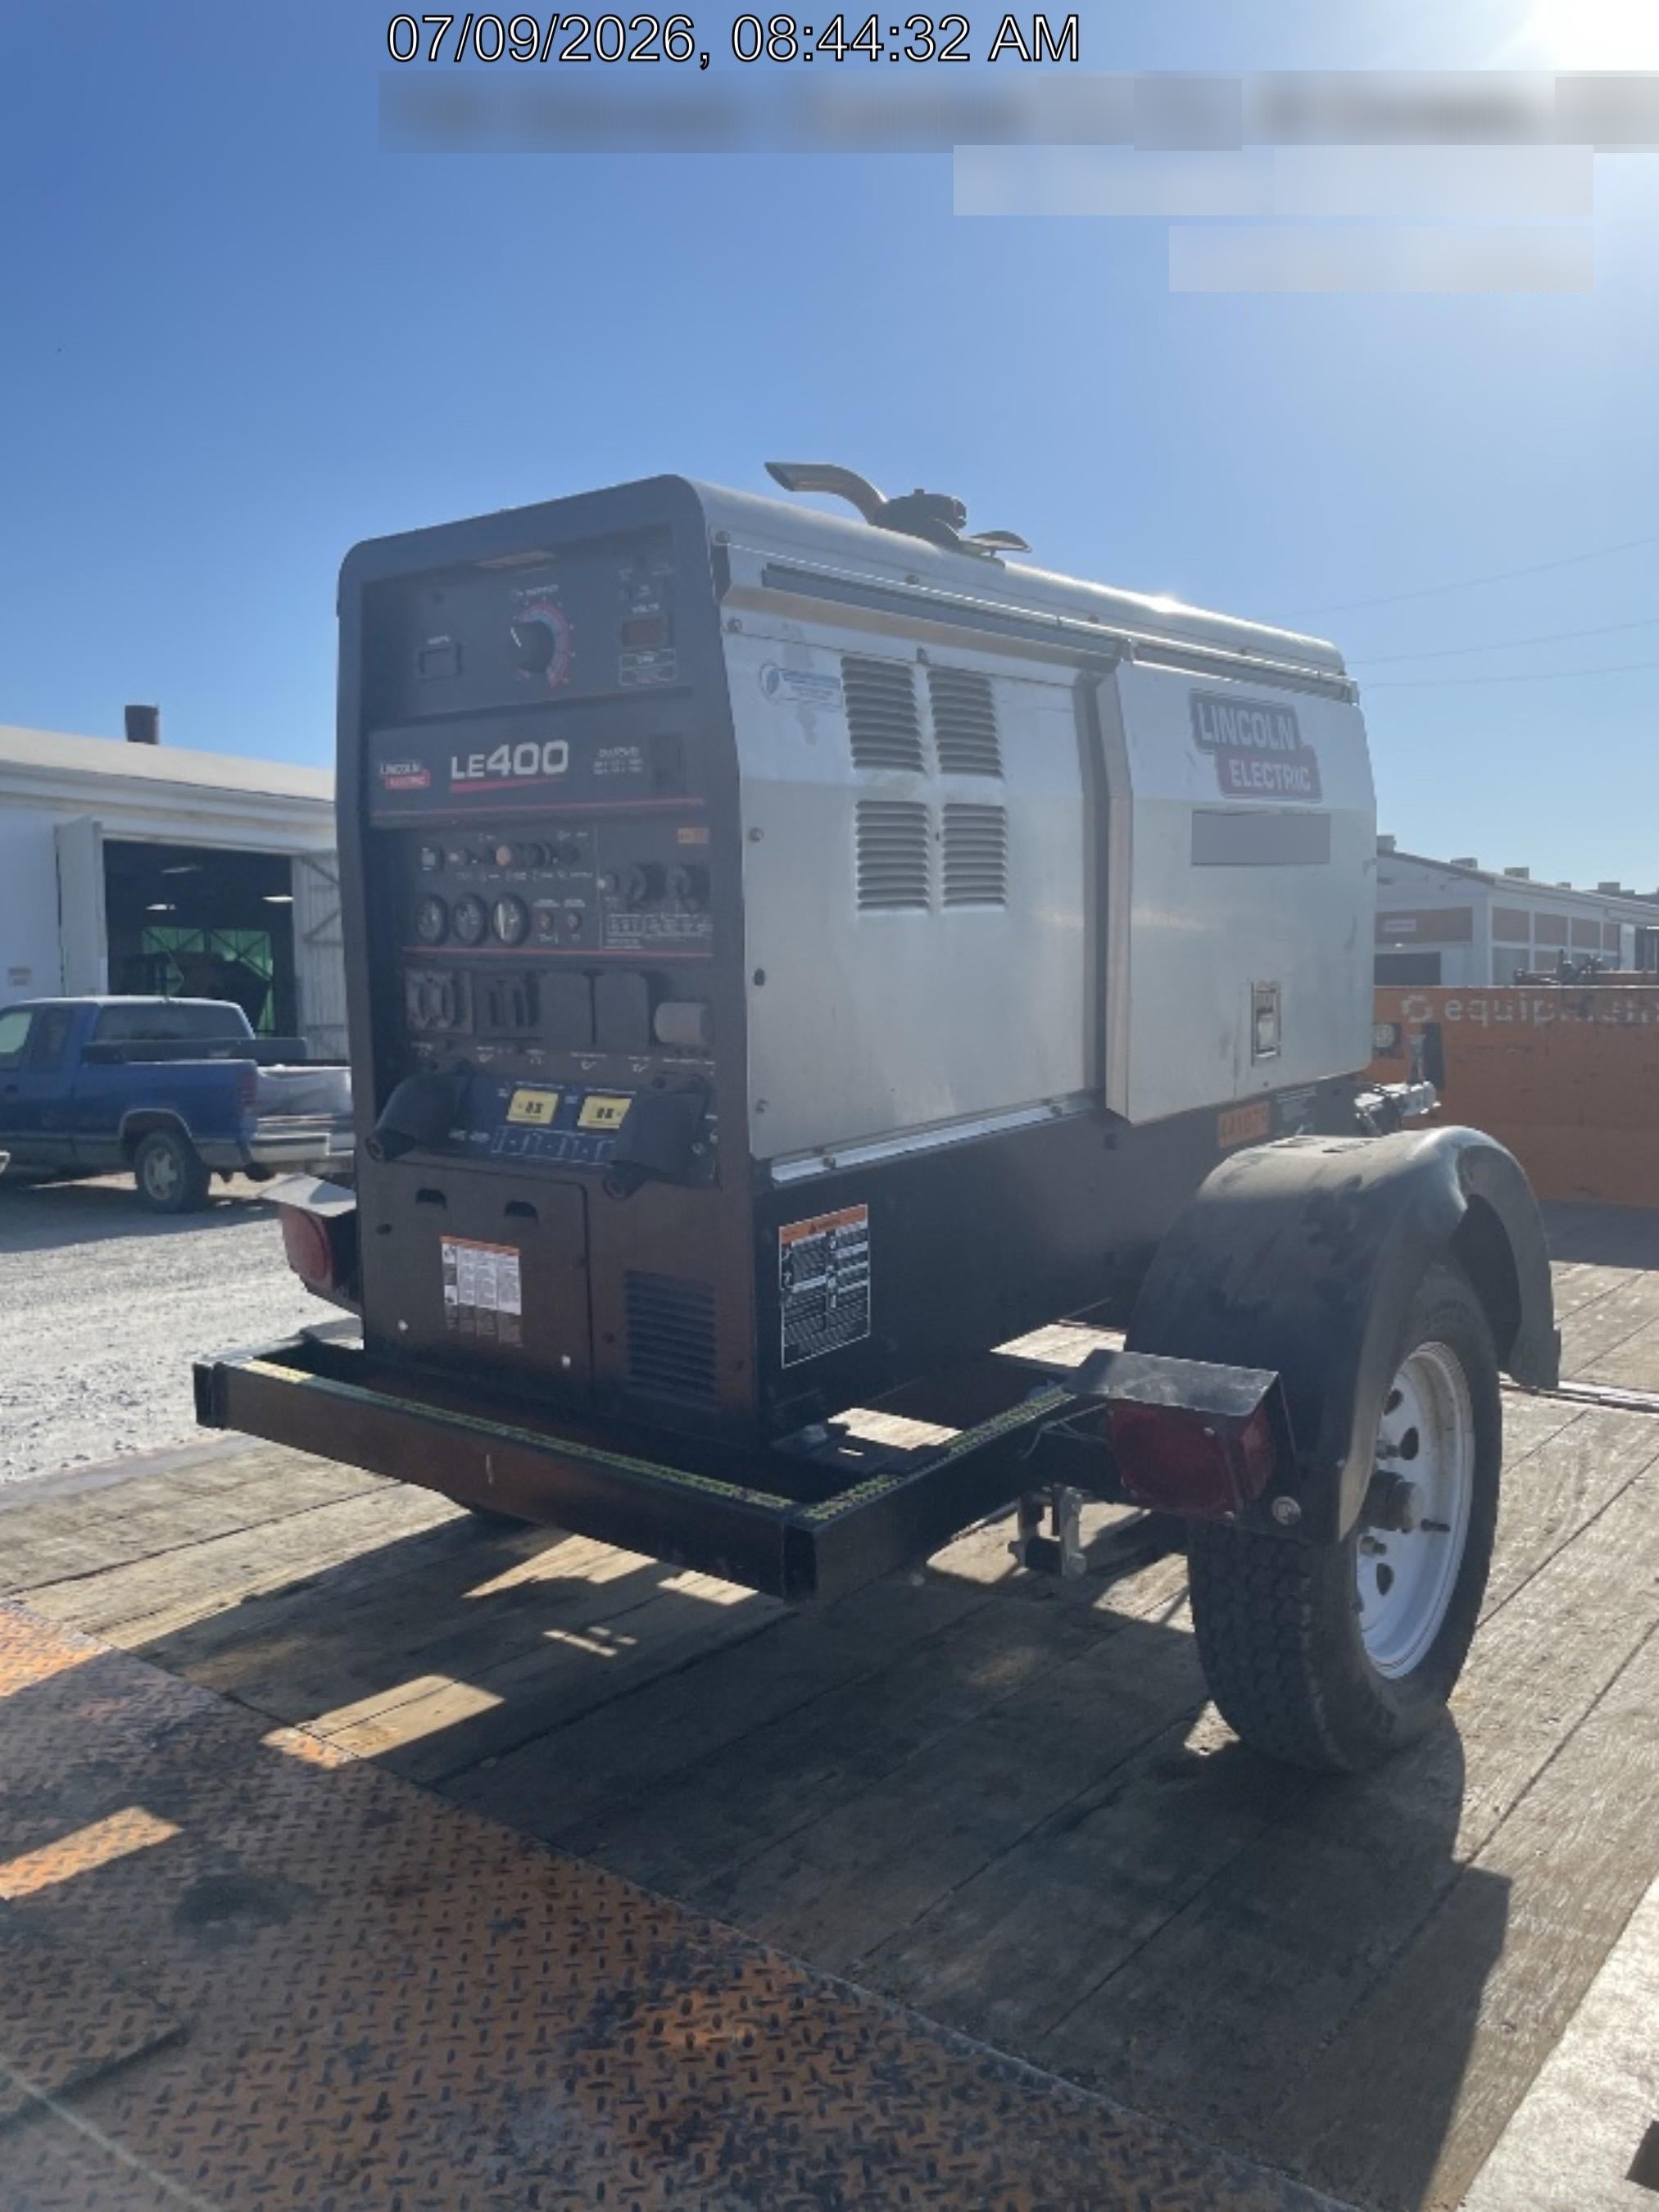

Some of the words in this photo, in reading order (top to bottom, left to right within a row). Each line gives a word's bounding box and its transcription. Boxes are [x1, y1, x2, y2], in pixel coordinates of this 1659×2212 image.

[1197, 702, 1297, 751] LINCOLN
[451, 740, 569, 780] LE400
[1228, 759, 1311, 792] ELECTRIC
